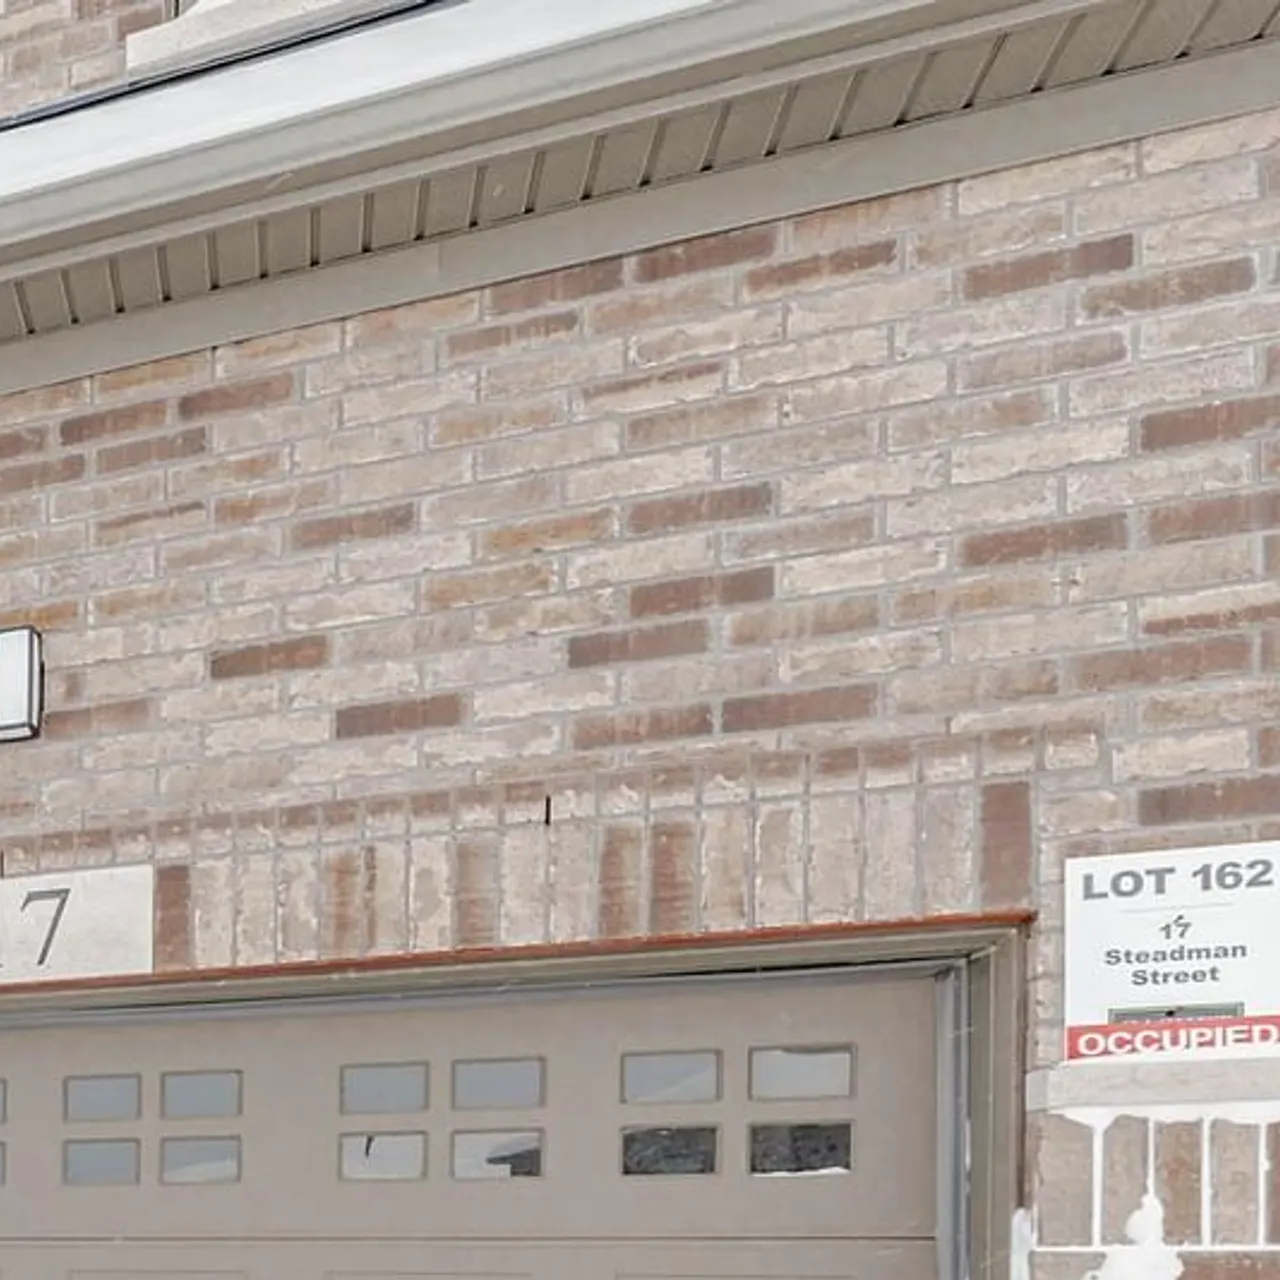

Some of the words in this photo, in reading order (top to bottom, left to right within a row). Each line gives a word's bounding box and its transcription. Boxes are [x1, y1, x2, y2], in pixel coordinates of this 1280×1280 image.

[1083, 867, 1176, 900] LOT
[1191, 859, 1274, 892] 162
[1159, 920, 1192, 940] 17
[1104, 944, 1248, 966] Steadman
[1131, 965, 1221, 986] Street
[1076, 1023, 1278, 1056] OCCUPIED
